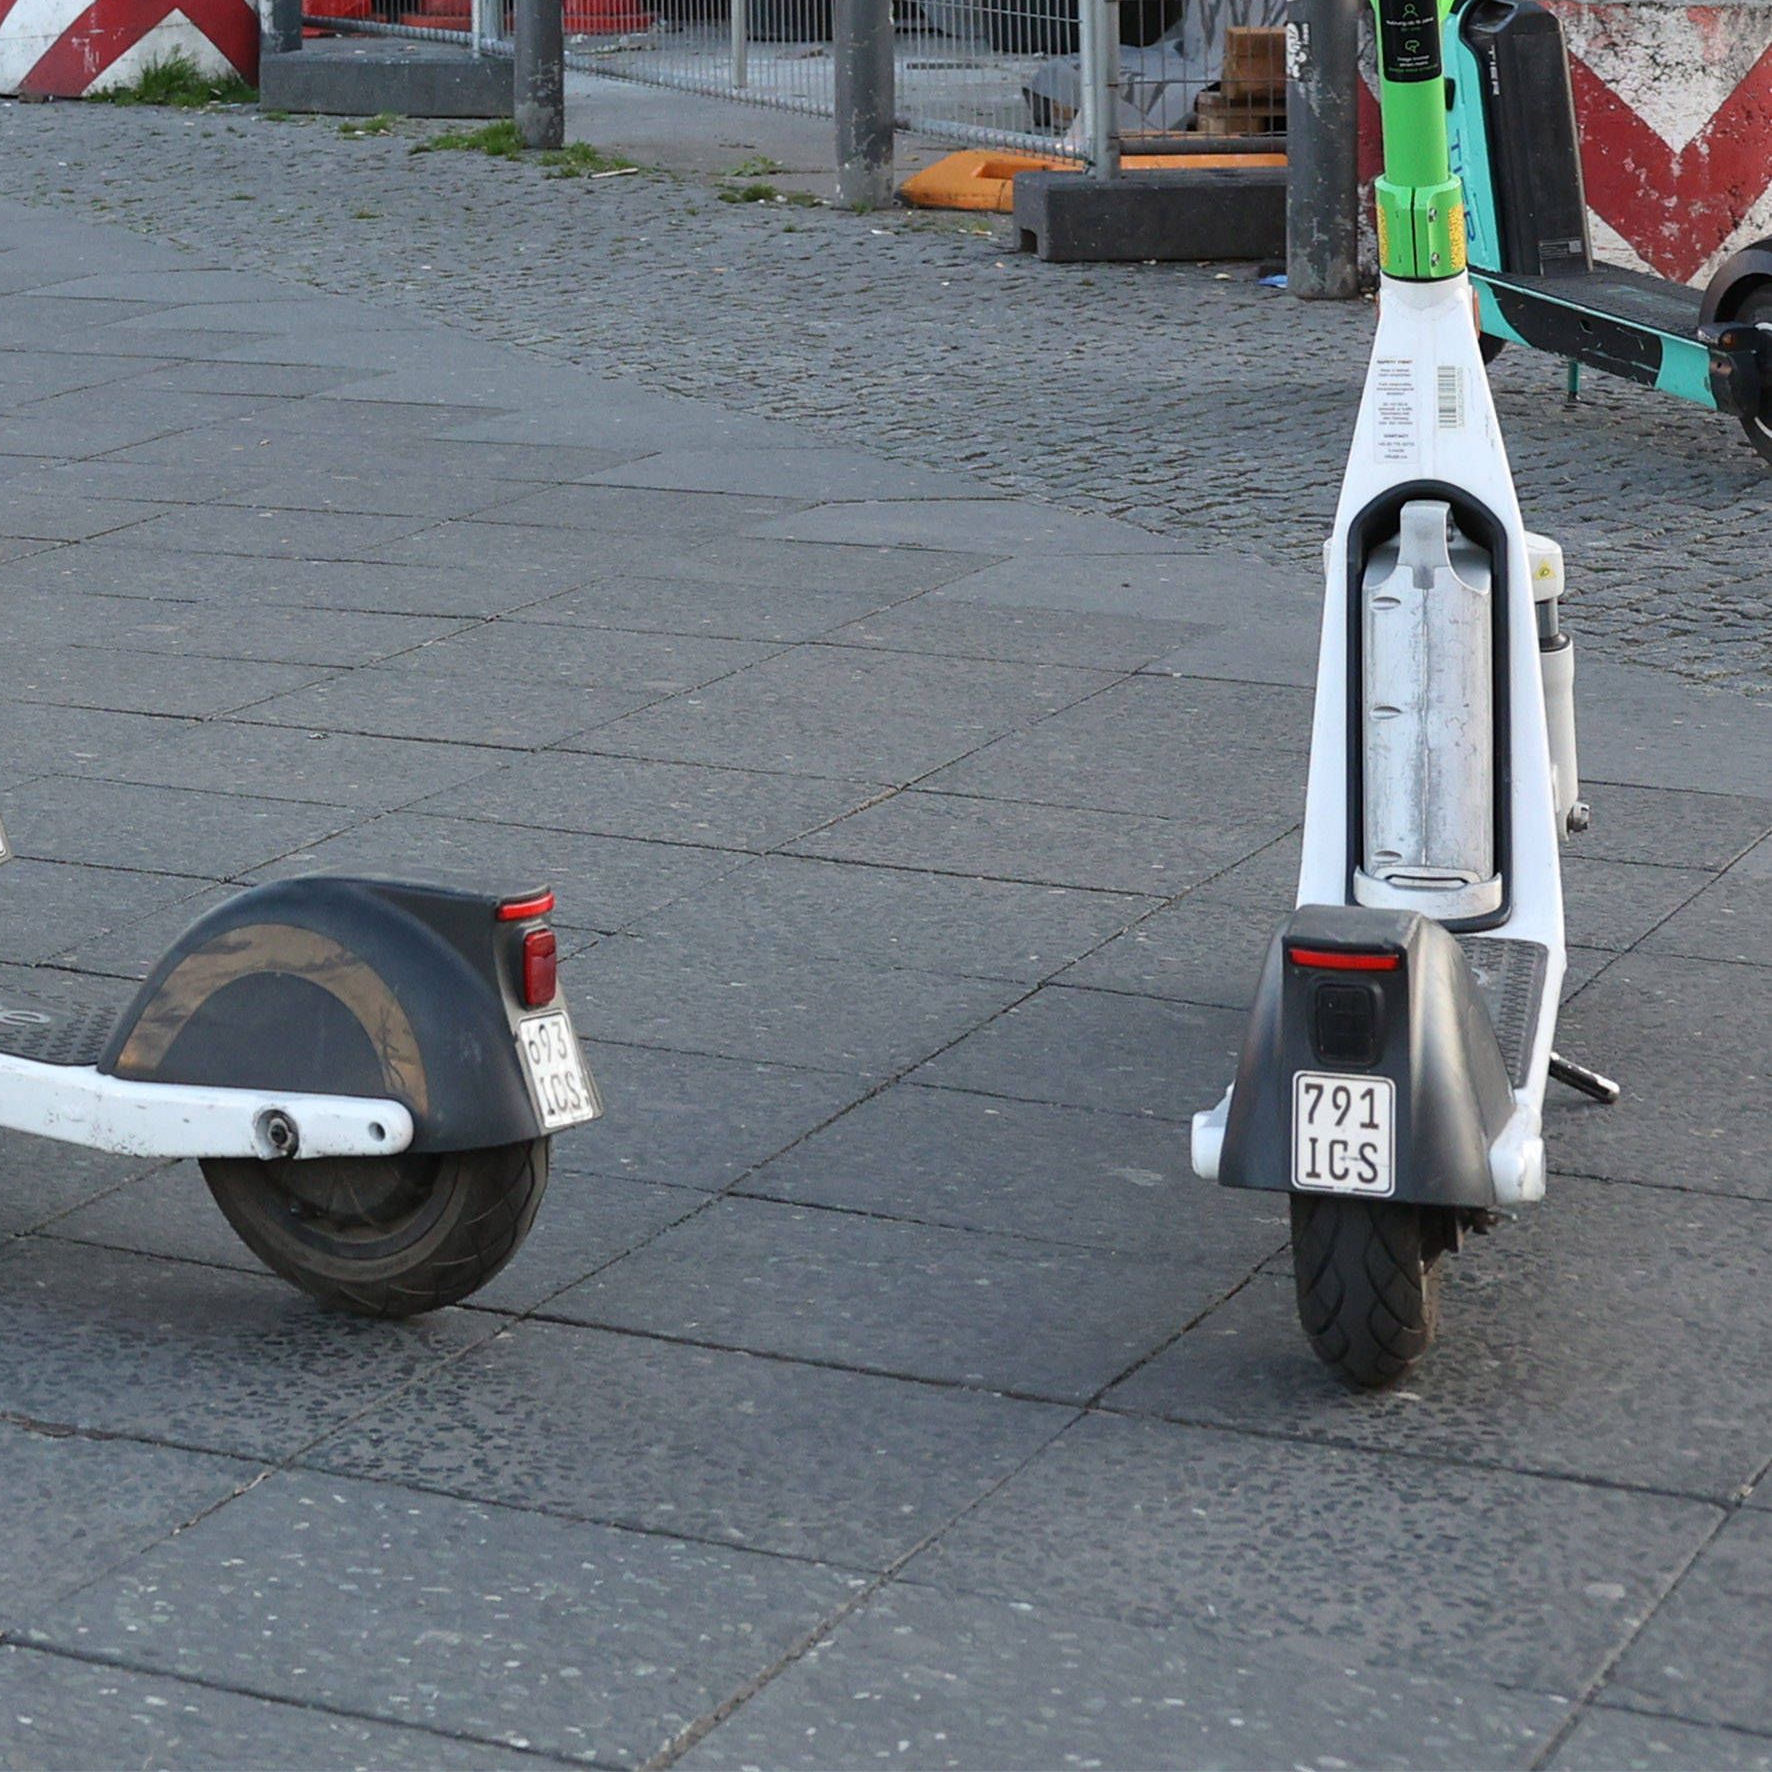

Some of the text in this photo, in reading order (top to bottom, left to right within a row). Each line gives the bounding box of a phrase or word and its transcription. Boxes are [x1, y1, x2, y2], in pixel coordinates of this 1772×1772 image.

[527, 1021, 568, 1065] 693
[540, 1070, 581, 1116] ICS
[1303, 1083, 1381, 1130] 791
[1304, 1136, 1381, 1184] ICS
